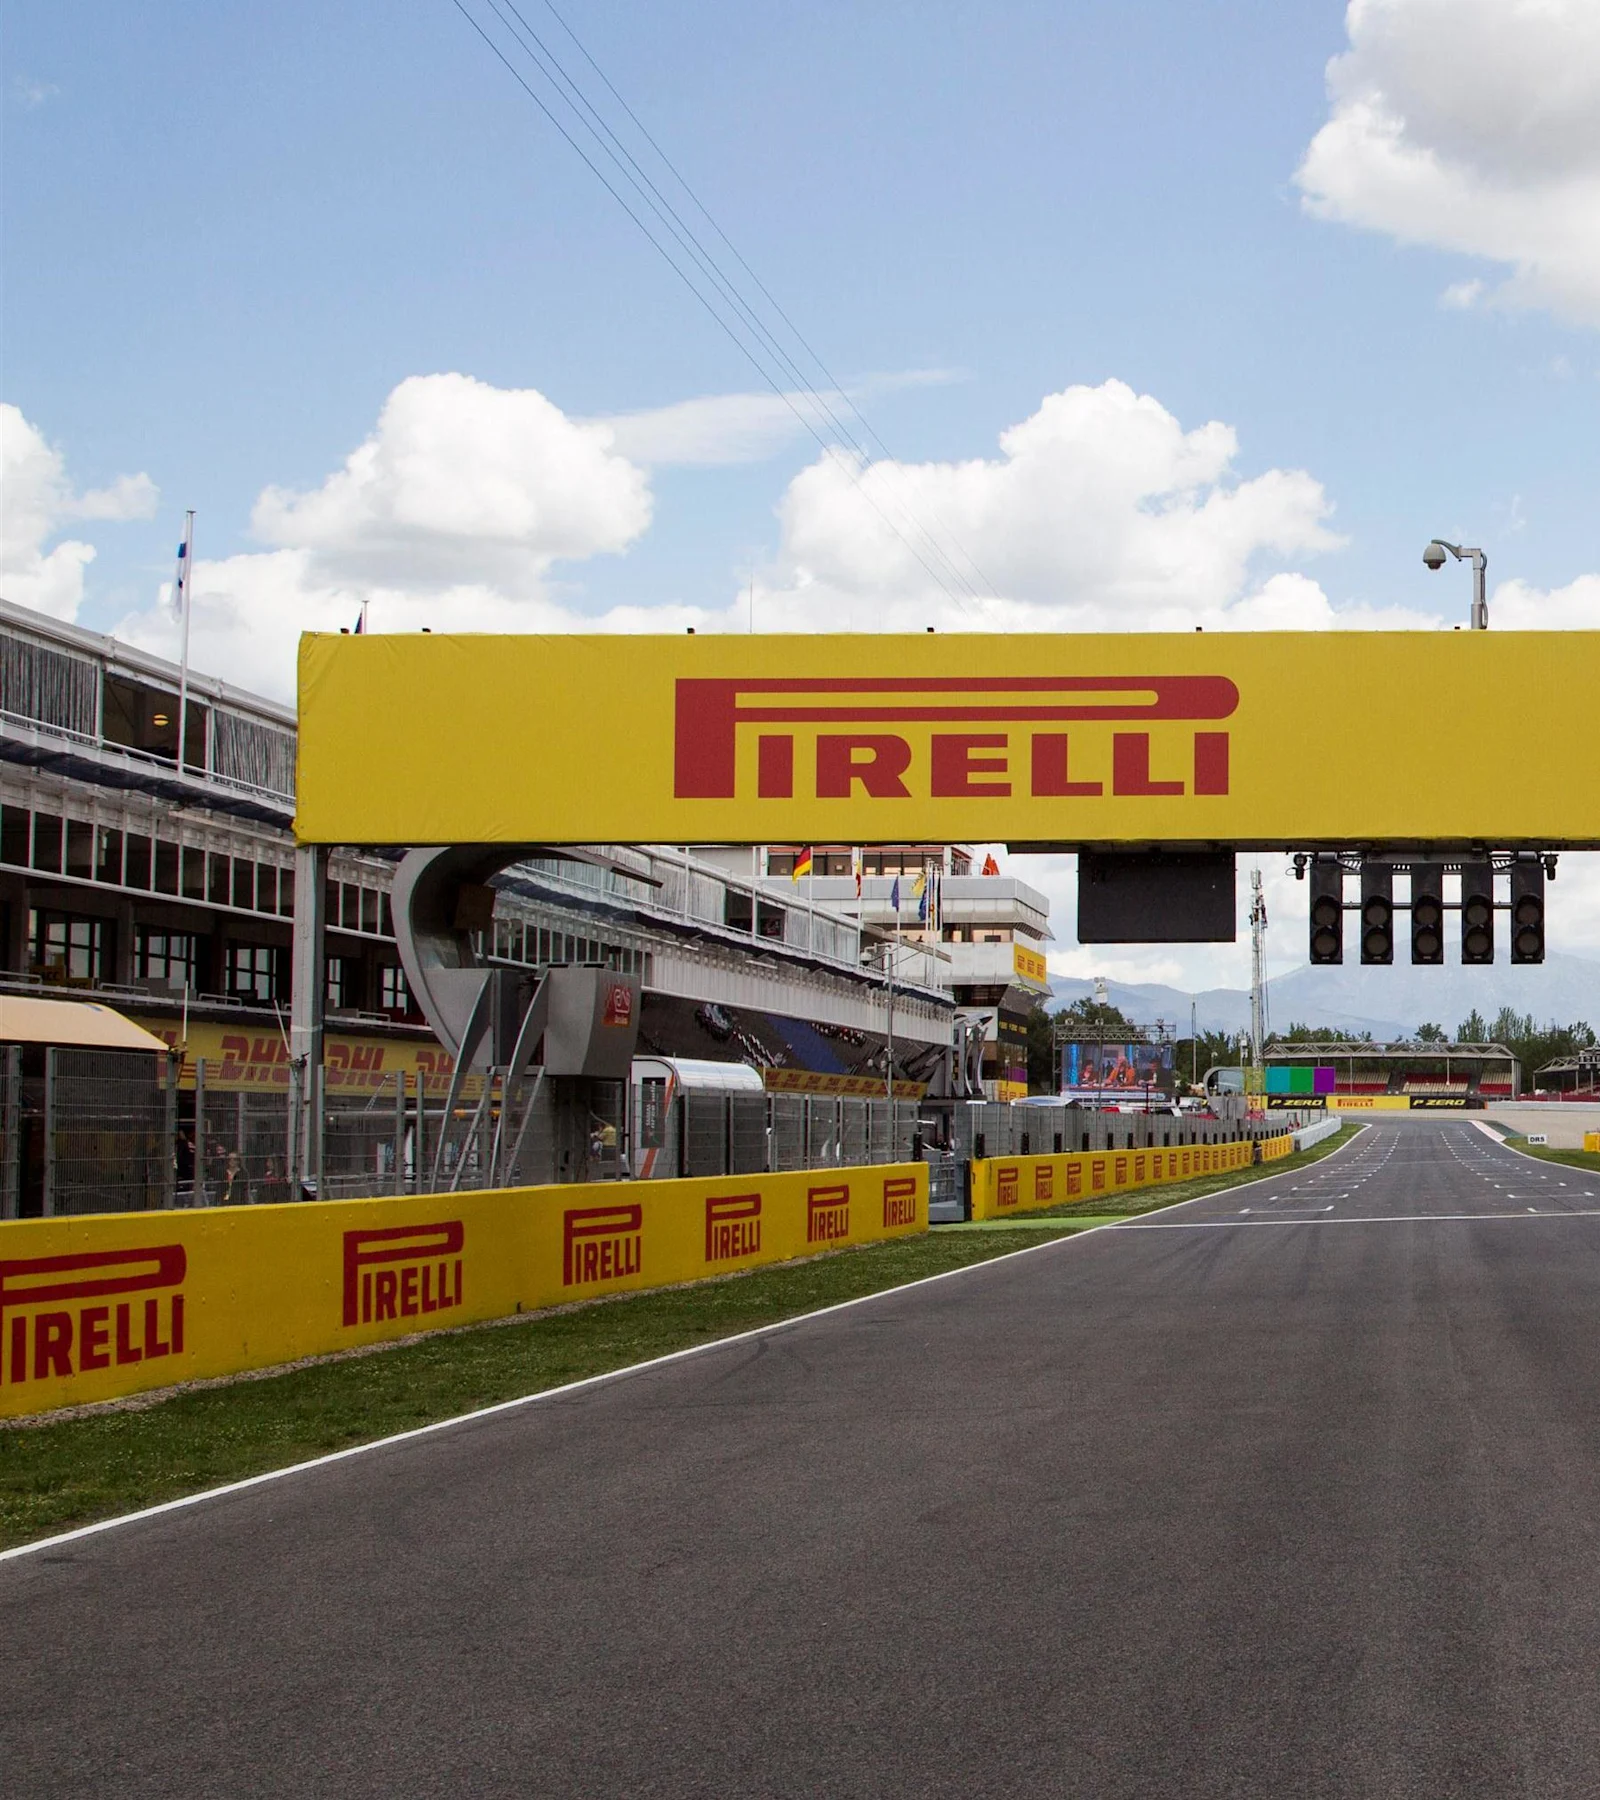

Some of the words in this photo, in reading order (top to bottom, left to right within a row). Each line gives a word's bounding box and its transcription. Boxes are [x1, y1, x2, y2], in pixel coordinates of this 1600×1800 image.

[675, 676, 1239, 799] PIRELLI
[327, 1044, 386, 1087] DHL
[415, 1051, 460, 1089] DH
[808, 1185, 849, 1243] PIRELLI
[884, 1178, 915, 1226] PIRELLI
[998, 1167, 1018, 1206] PIRELLI
[563, 1204, 642, 1285] PIRELLI
[706, 1194, 761, 1261] PIRELLI
[343, 1221, 464, 1326] PIRELLI
[0, 1244, 187, 1385] PIRELLI
